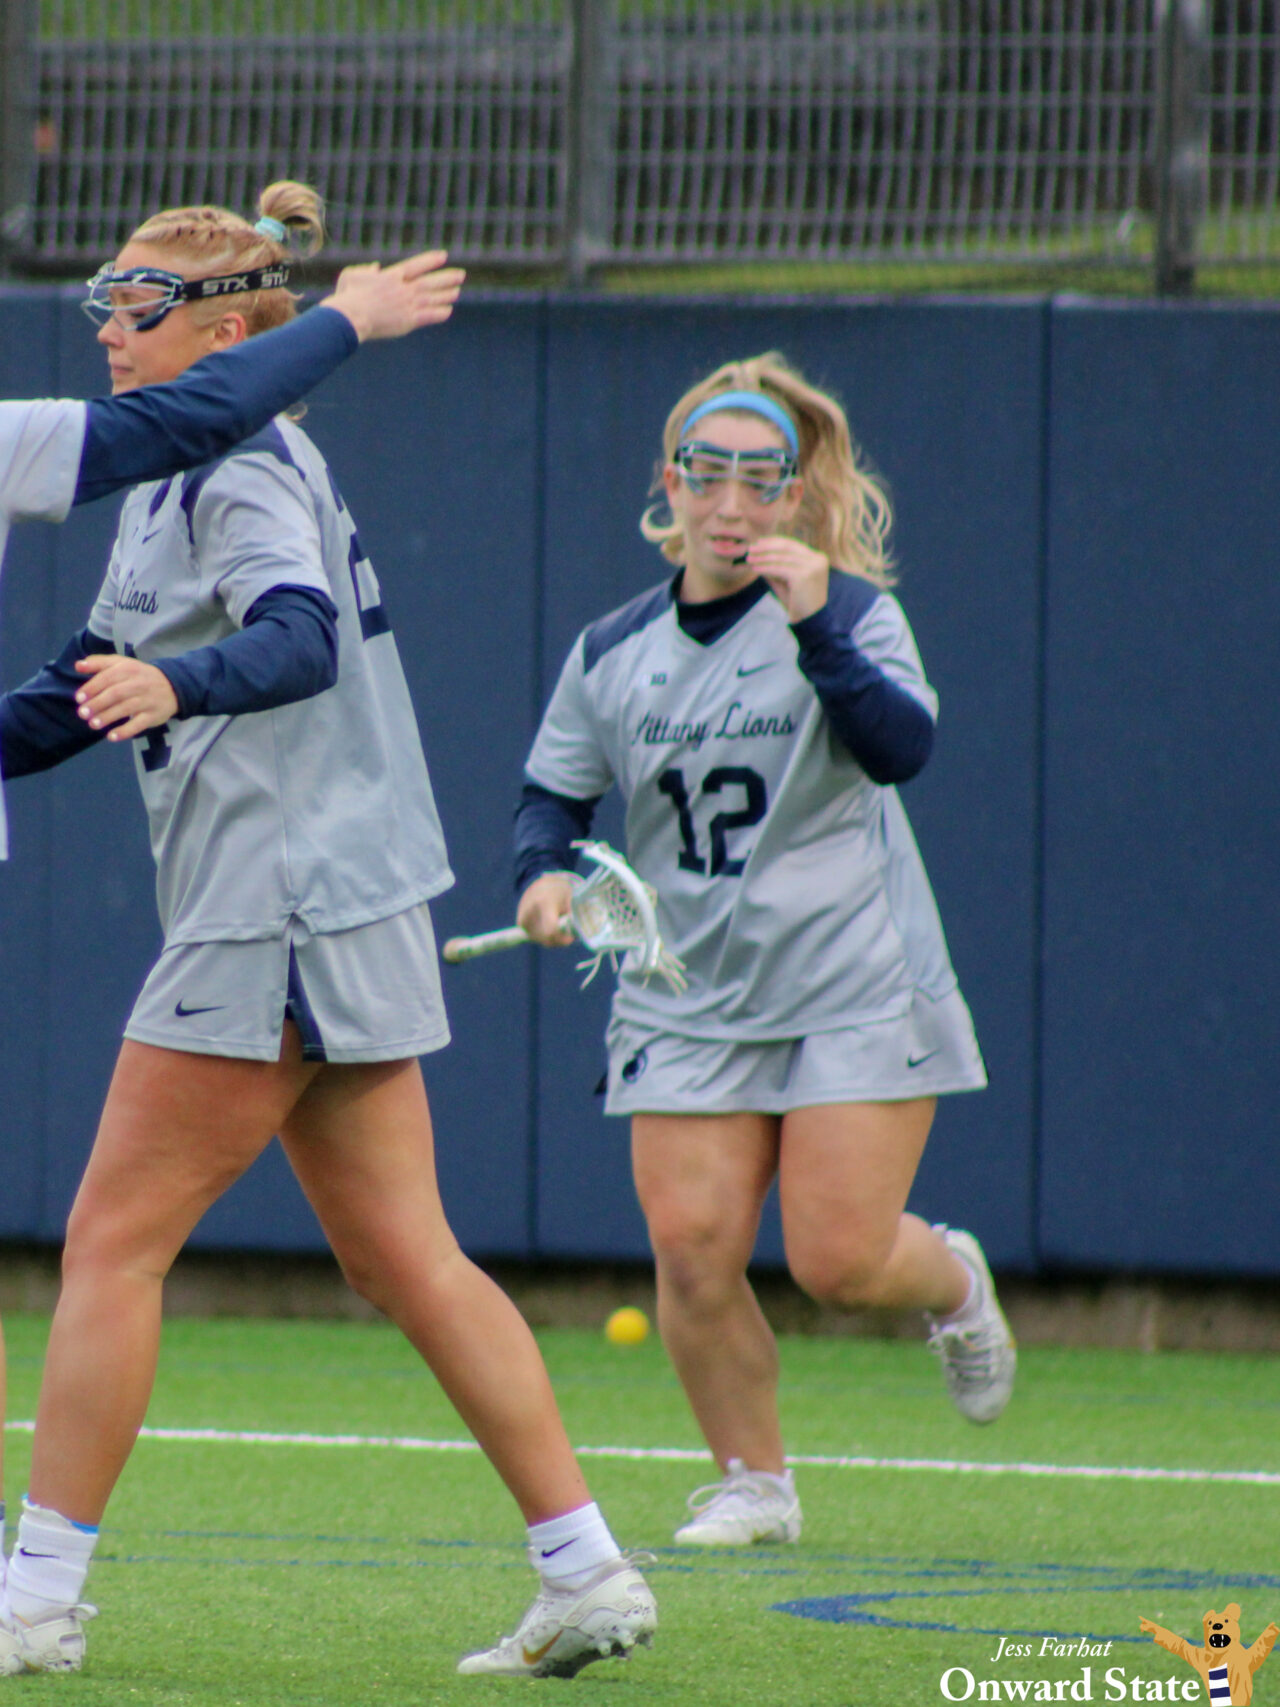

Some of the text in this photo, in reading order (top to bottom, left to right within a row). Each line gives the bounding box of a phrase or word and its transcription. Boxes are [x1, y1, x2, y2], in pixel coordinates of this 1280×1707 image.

[202, 275, 249, 296] STX
[715, 702, 797, 740] Lions
[658, 766, 768, 878] 12
